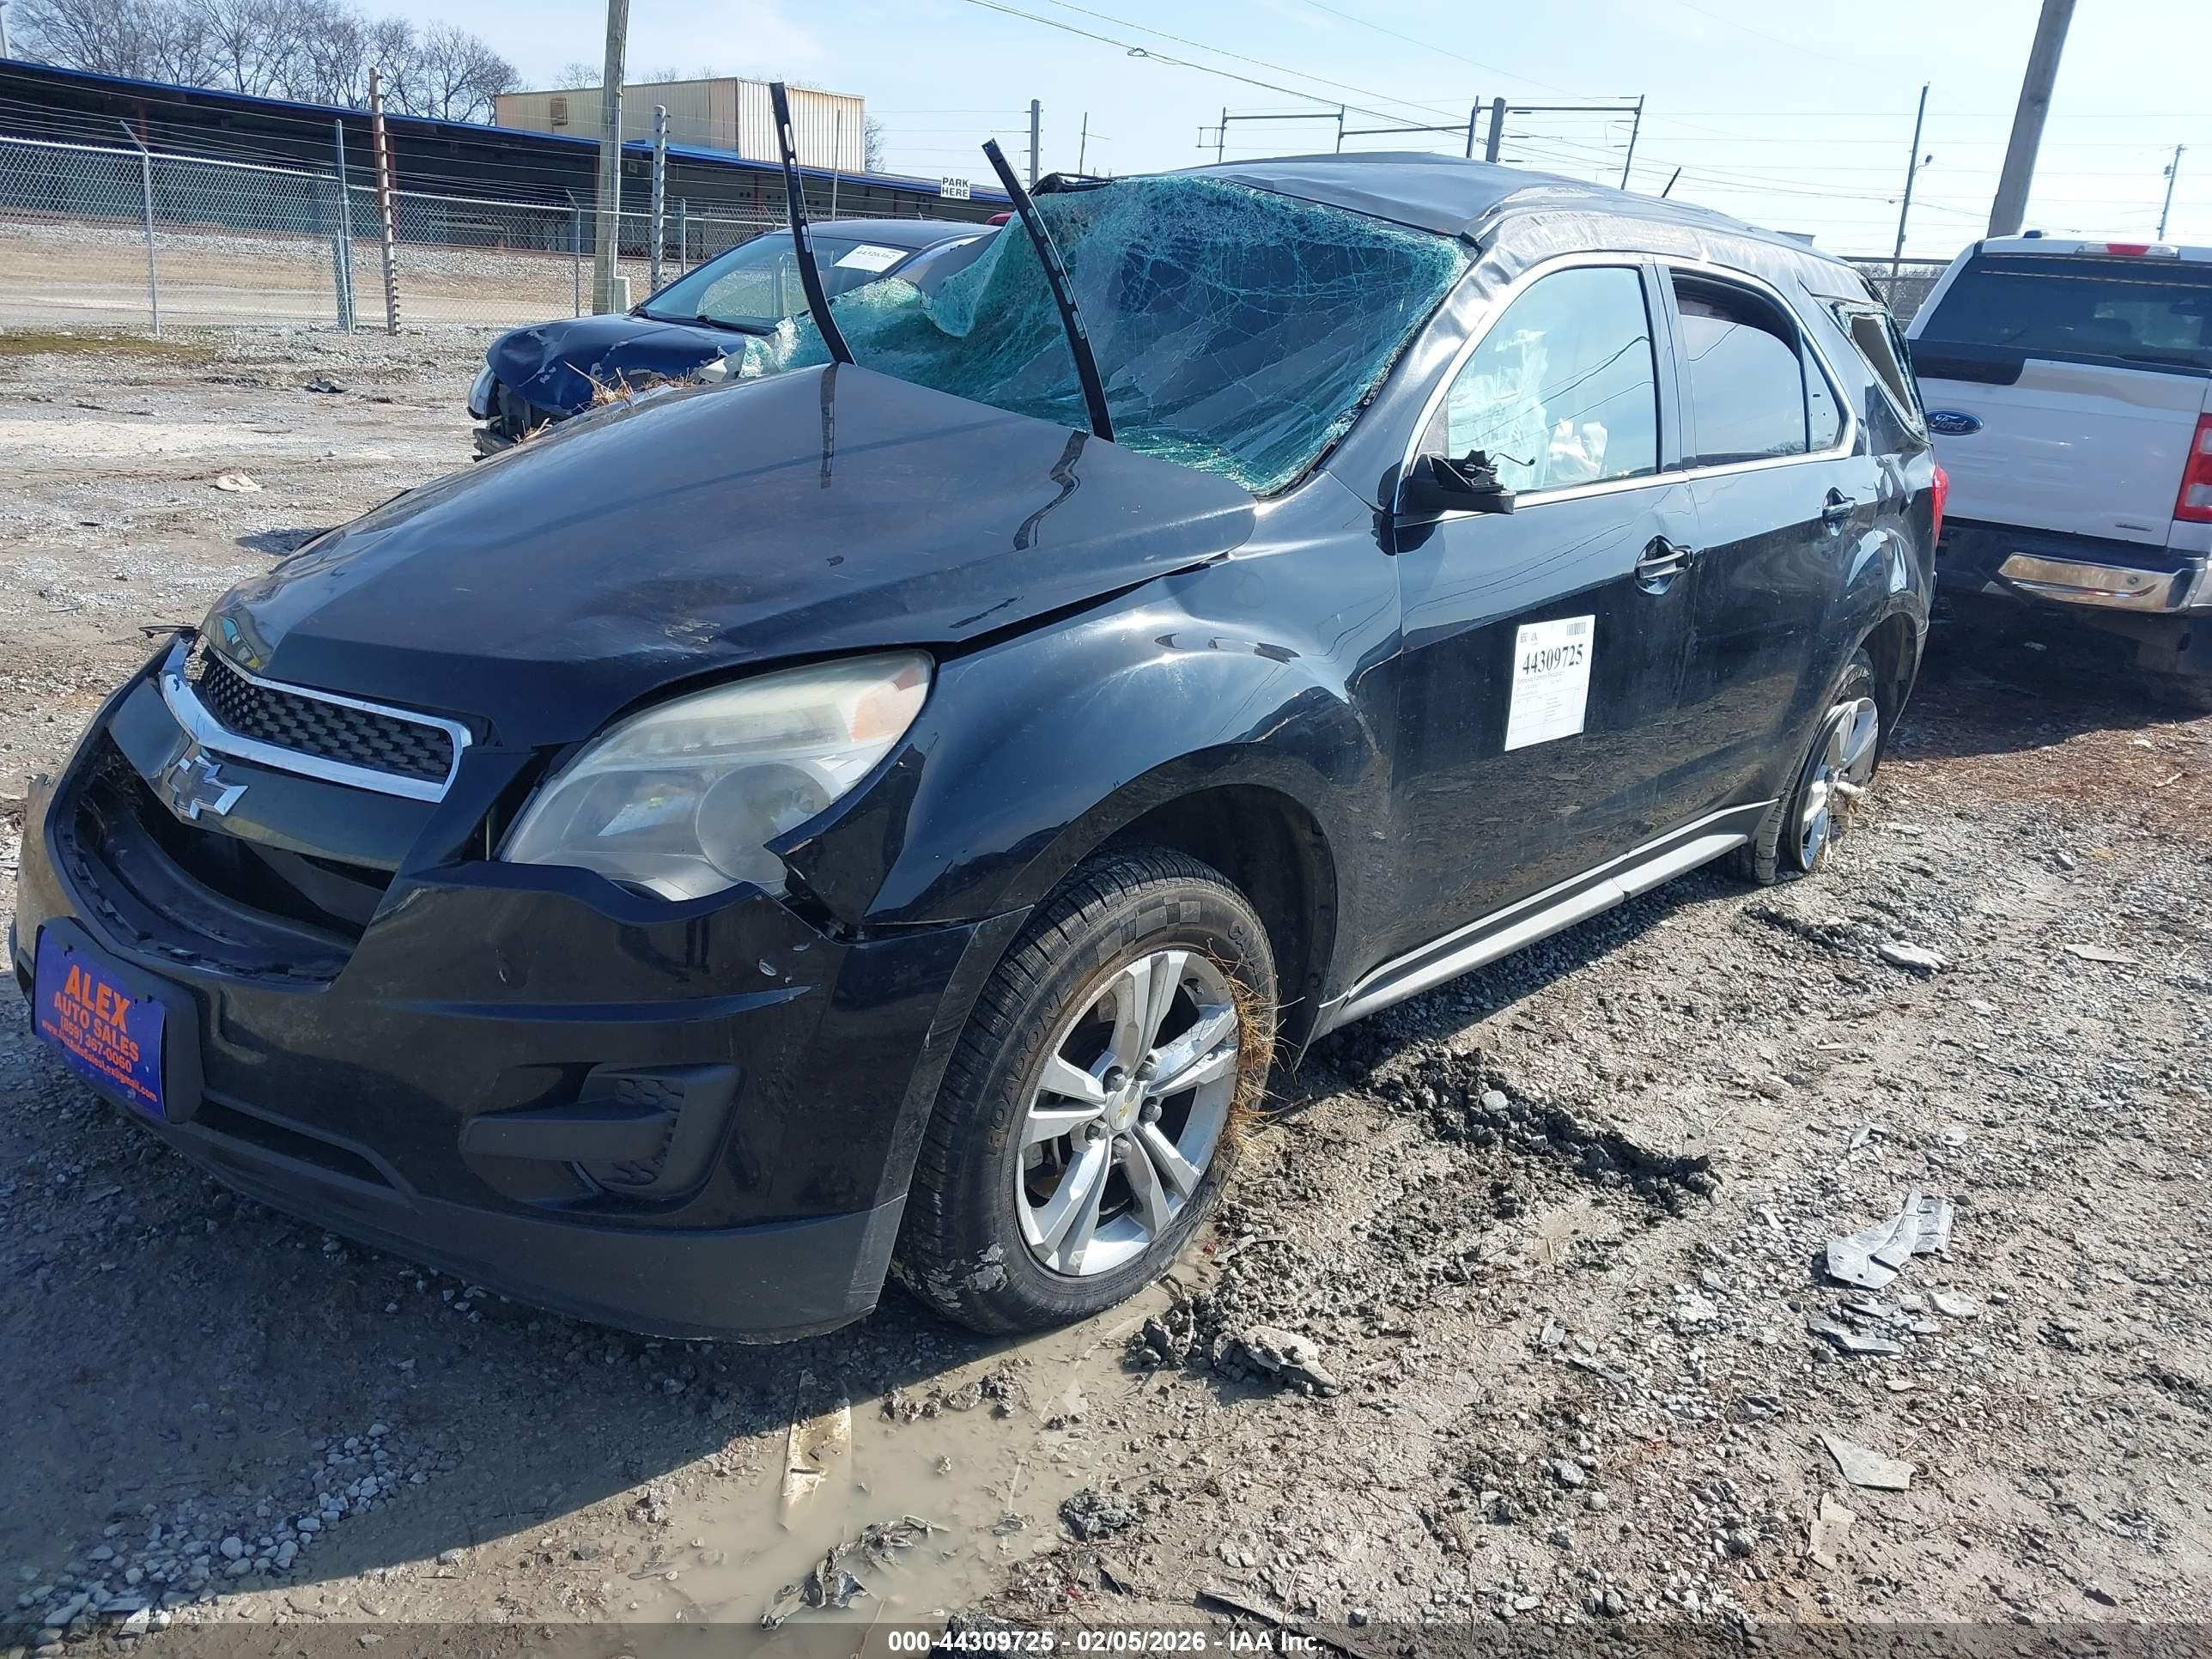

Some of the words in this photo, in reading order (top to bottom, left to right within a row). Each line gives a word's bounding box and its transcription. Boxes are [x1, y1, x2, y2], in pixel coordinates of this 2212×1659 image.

[942, 177, 970, 188] PARK
[942, 186, 969, 198] HERE
[1930, 413, 1968, 432] Ford
[1522, 644, 1583, 675] 44309725
[64, 964, 131, 1034] ALEX
[54, 991, 90, 1029] AUTO
[93, 1018, 139, 1062] SALES
[60, 1016, 83, 1045] (859)
